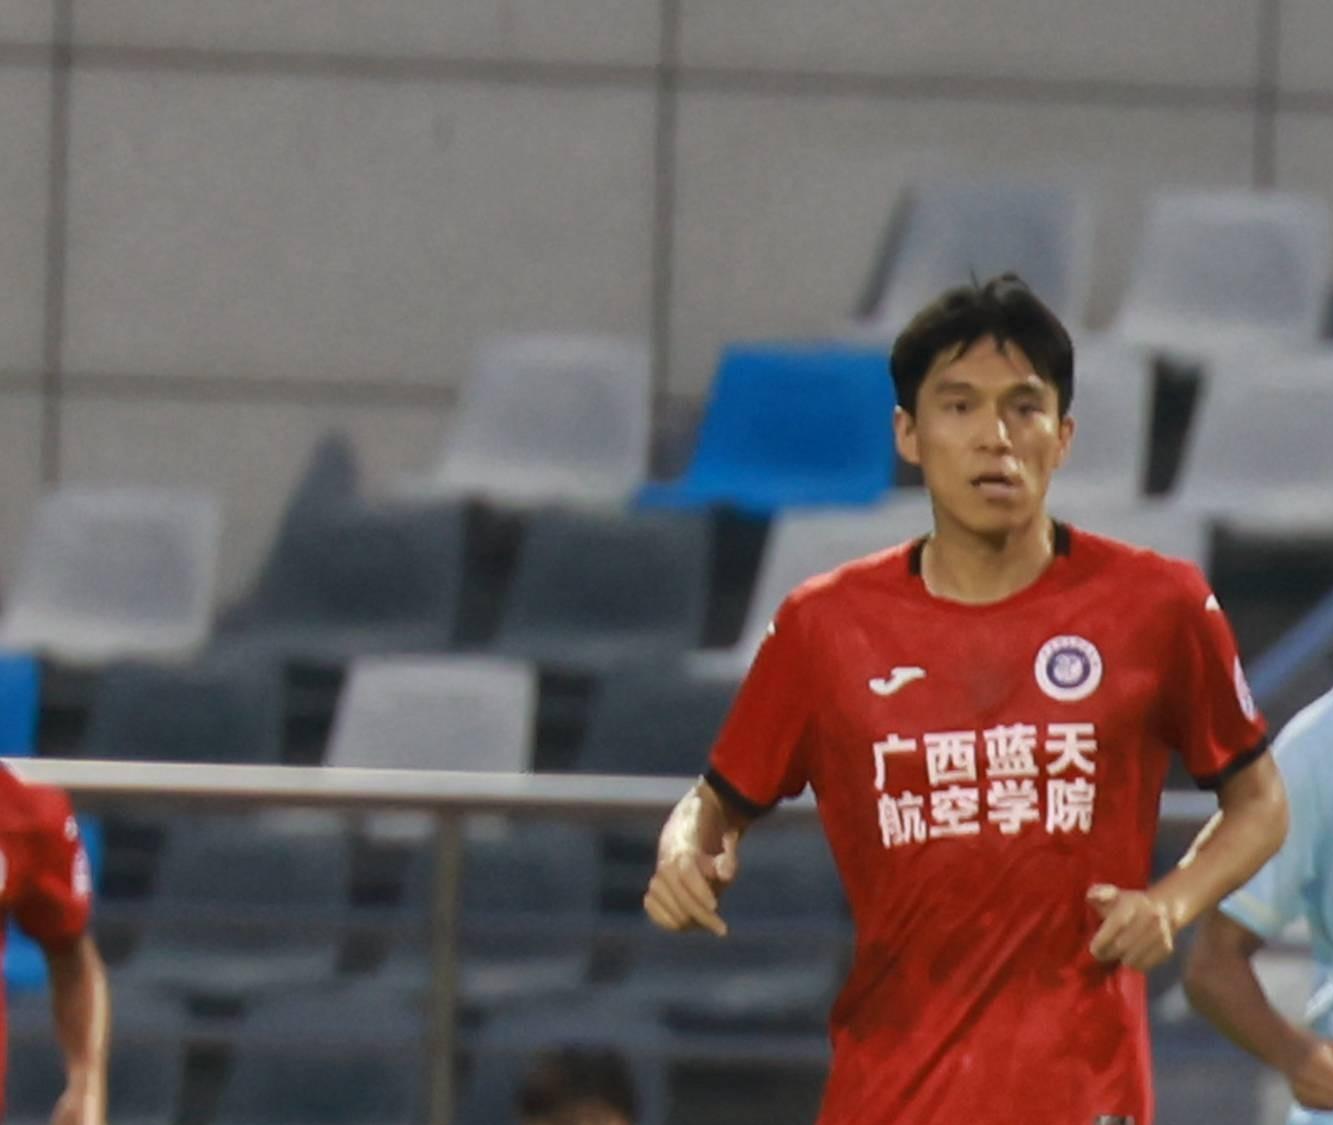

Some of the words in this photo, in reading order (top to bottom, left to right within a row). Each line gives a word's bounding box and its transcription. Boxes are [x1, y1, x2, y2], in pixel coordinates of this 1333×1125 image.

[872, 722, 1098, 791] 广西蓝天
[876, 777, 1097, 848] 航空学院
